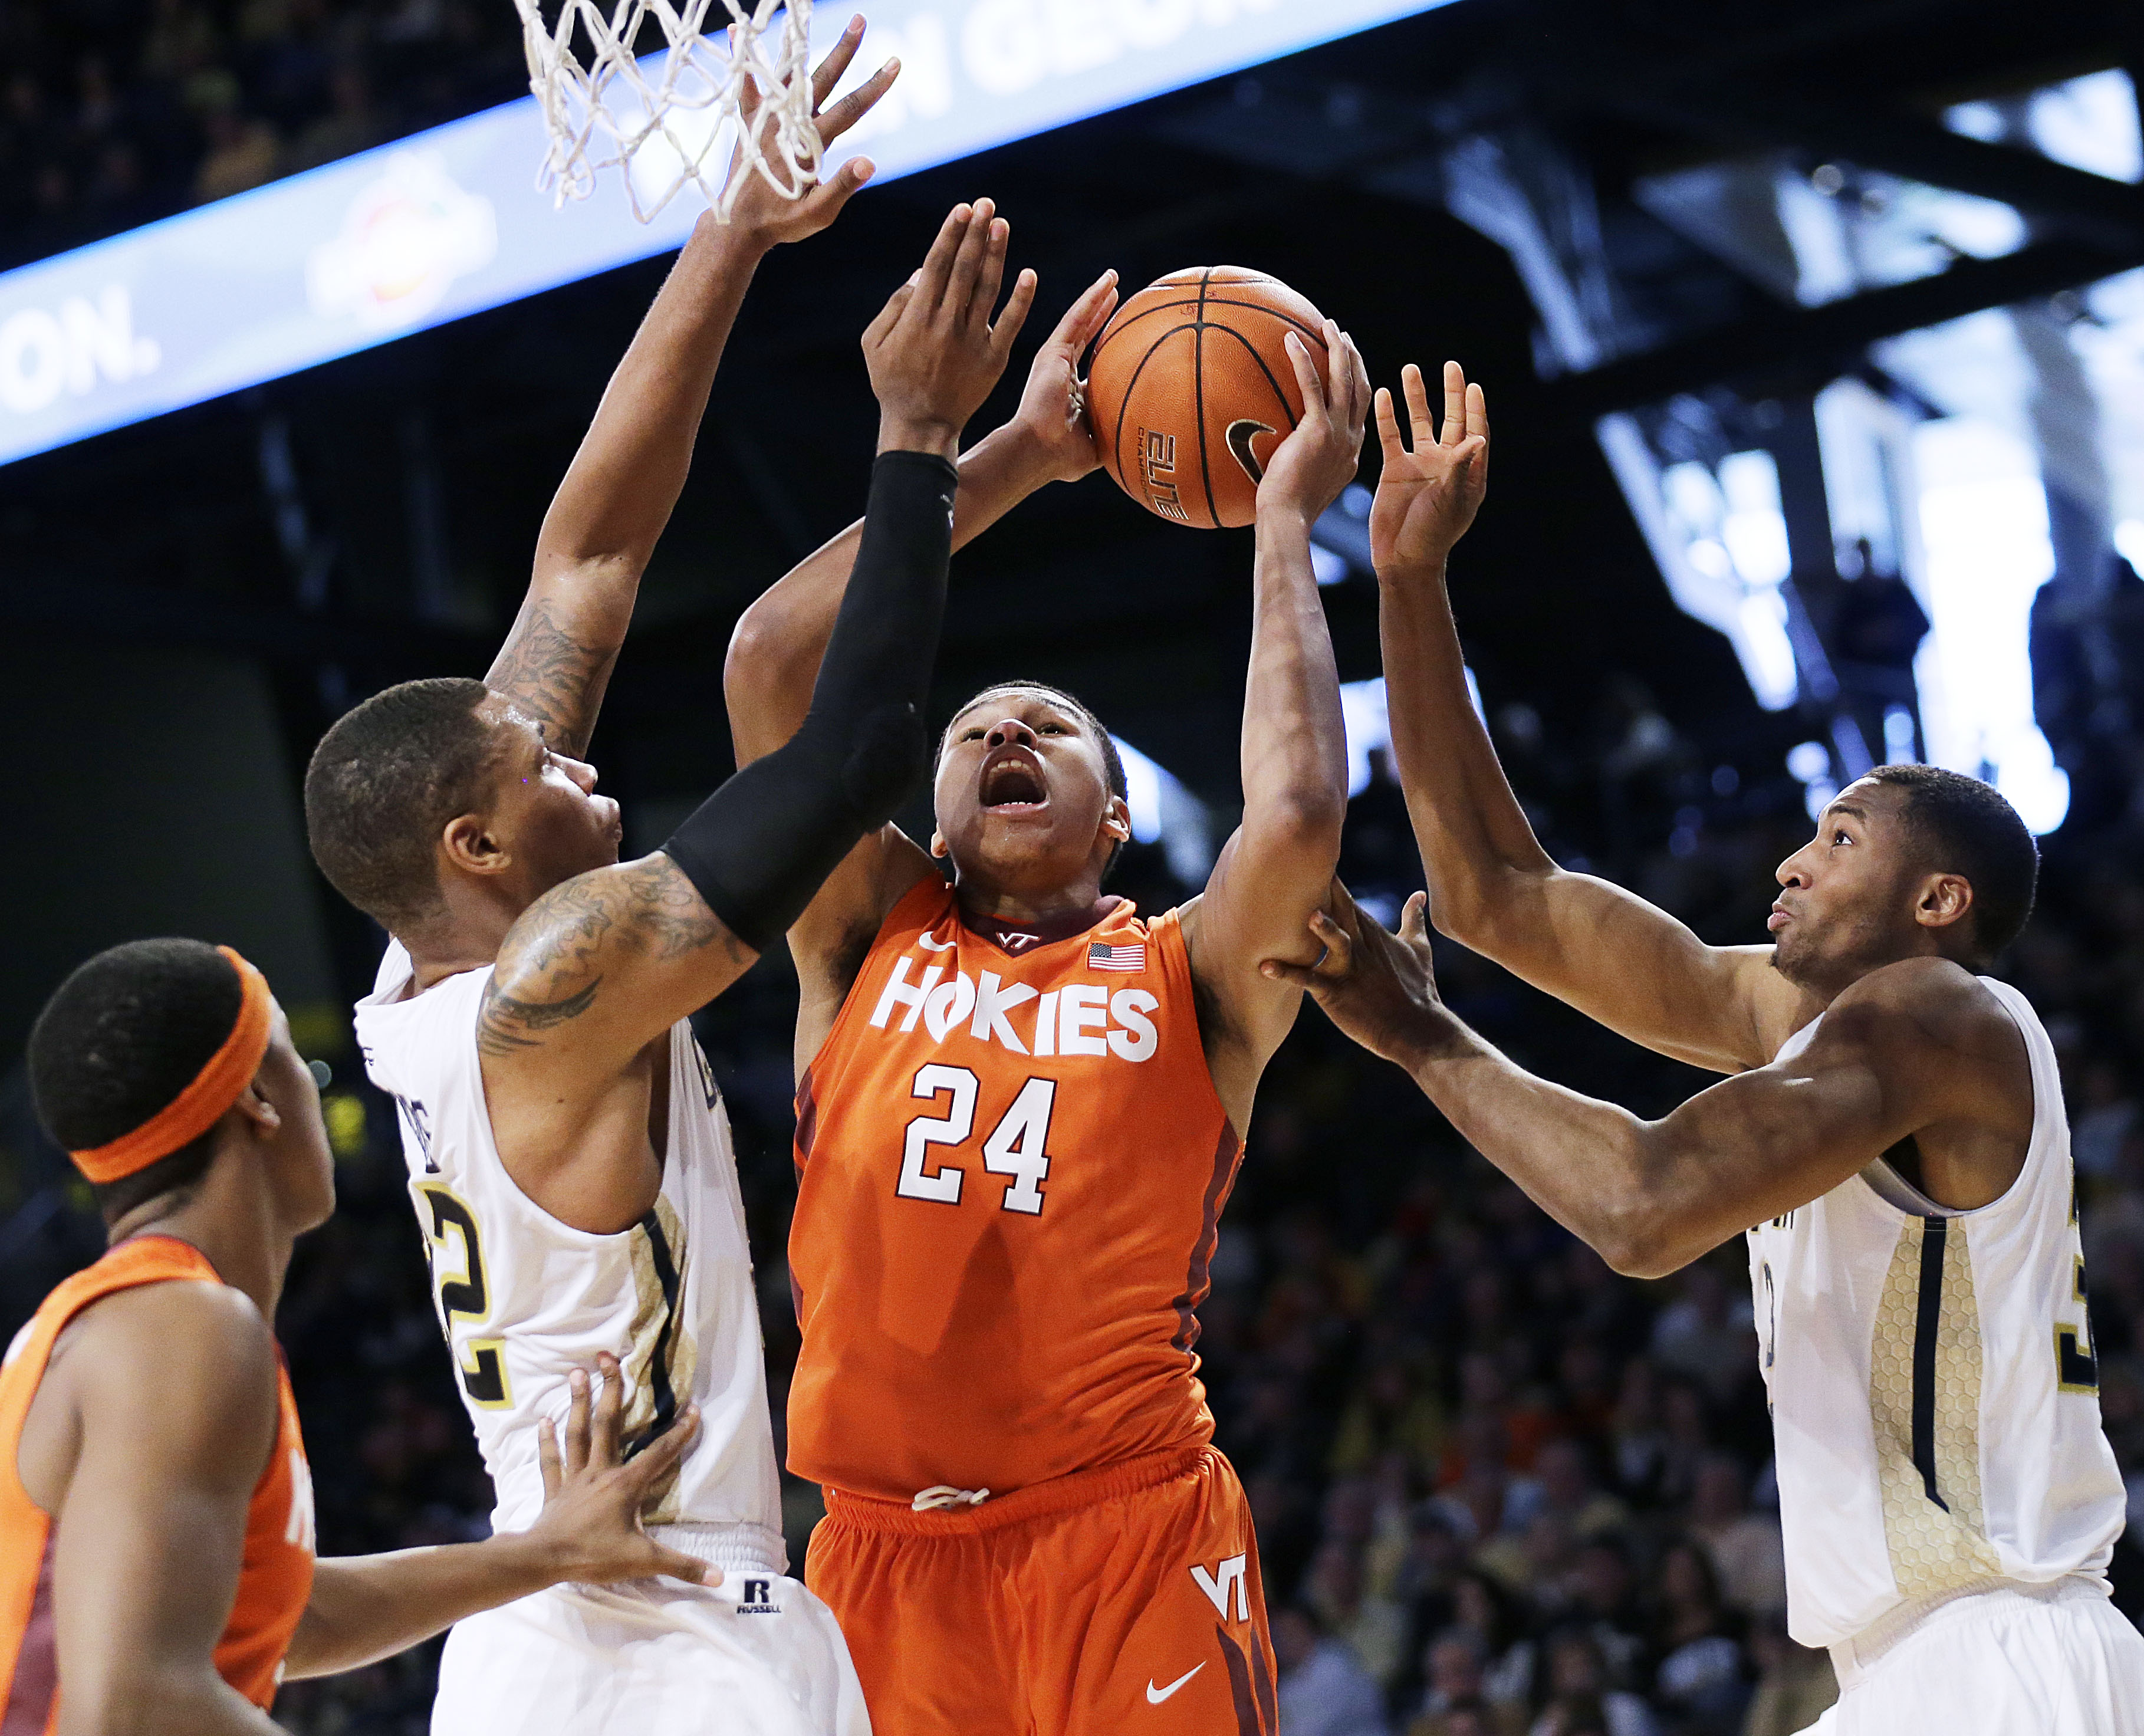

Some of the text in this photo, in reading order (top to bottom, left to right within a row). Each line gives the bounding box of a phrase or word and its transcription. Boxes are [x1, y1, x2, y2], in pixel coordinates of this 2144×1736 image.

[1147, 430, 1189, 520] ELITE
[995, 932, 1043, 949] VT
[870, 956, 1159, 1062] HOKIES
[895, 1063, 1058, 1216] 24
[736, 1605, 781, 1614] RUSSELL
[744, 1579, 770, 1603] R
[1188, 1550, 1252, 1626] VT
